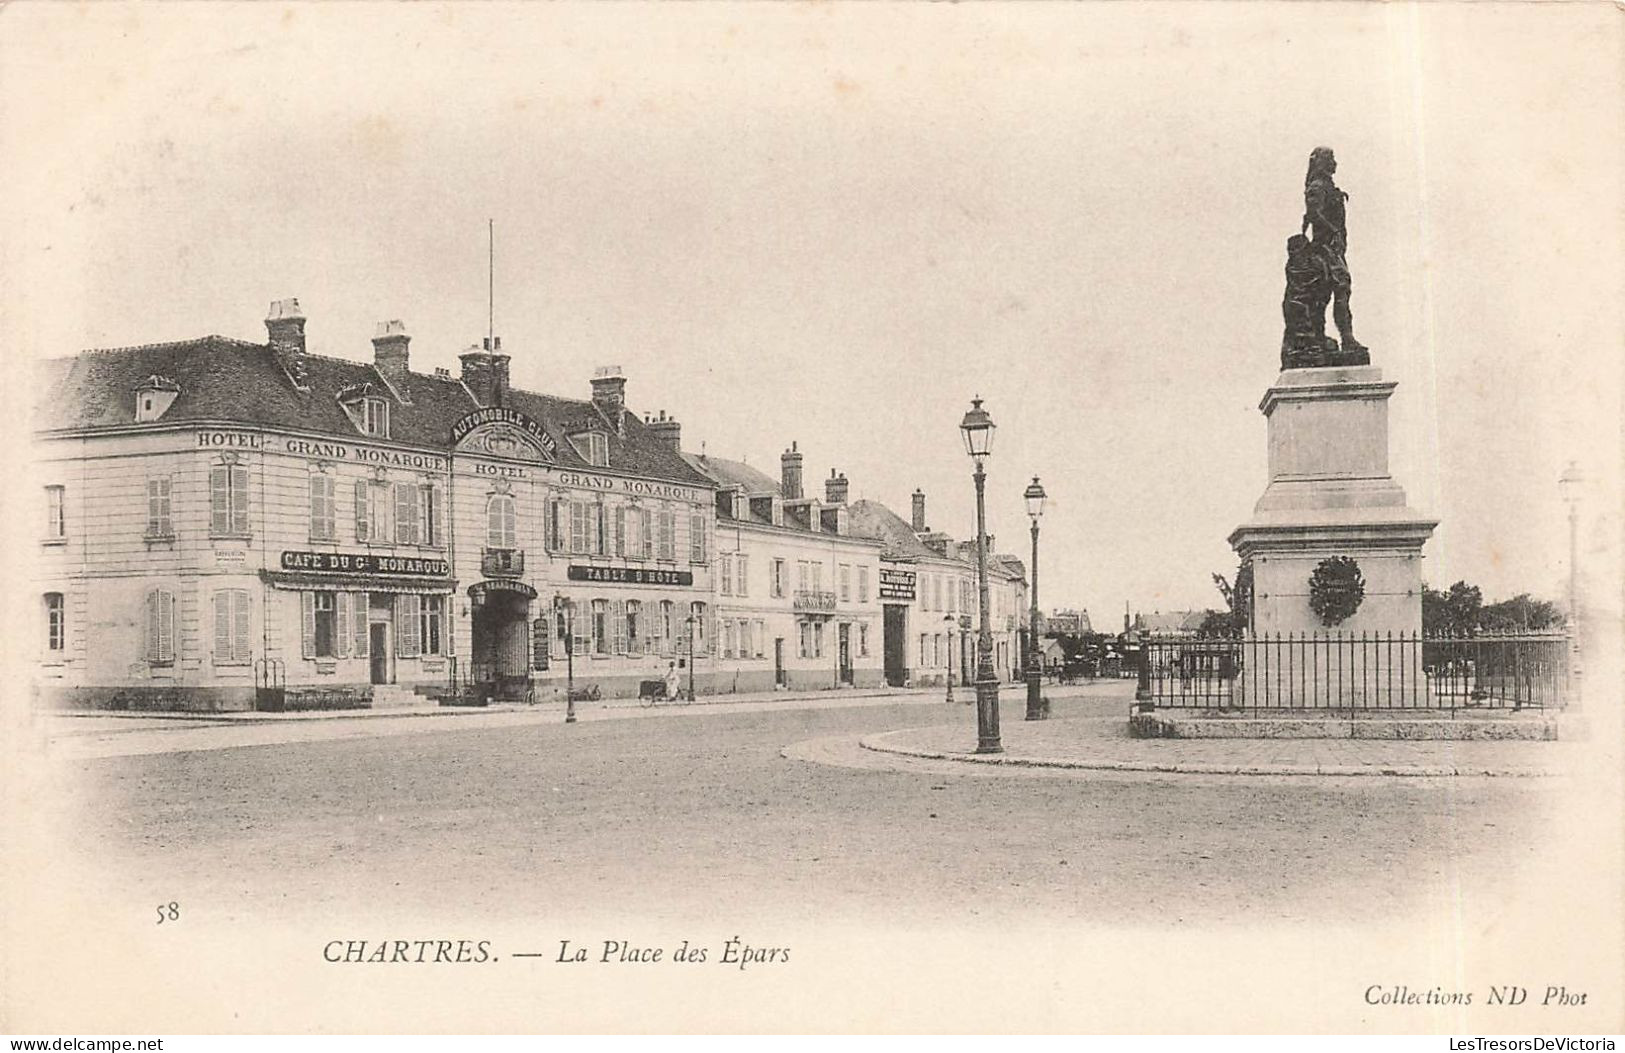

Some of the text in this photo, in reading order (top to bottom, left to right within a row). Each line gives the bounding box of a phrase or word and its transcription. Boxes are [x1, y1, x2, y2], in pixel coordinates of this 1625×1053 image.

[453, 408, 557, 452] AUTOMOBILE CLUB
[197, 432, 445, 470] HOTEL GRAND MONARQUE
[475, 464, 699, 500] HOTEL GRAND MONARQUE
[330, 555, 350, 569] DU
[378, 559, 449, 574] MONARQUE
[586, 568, 627, 580] TABLE
